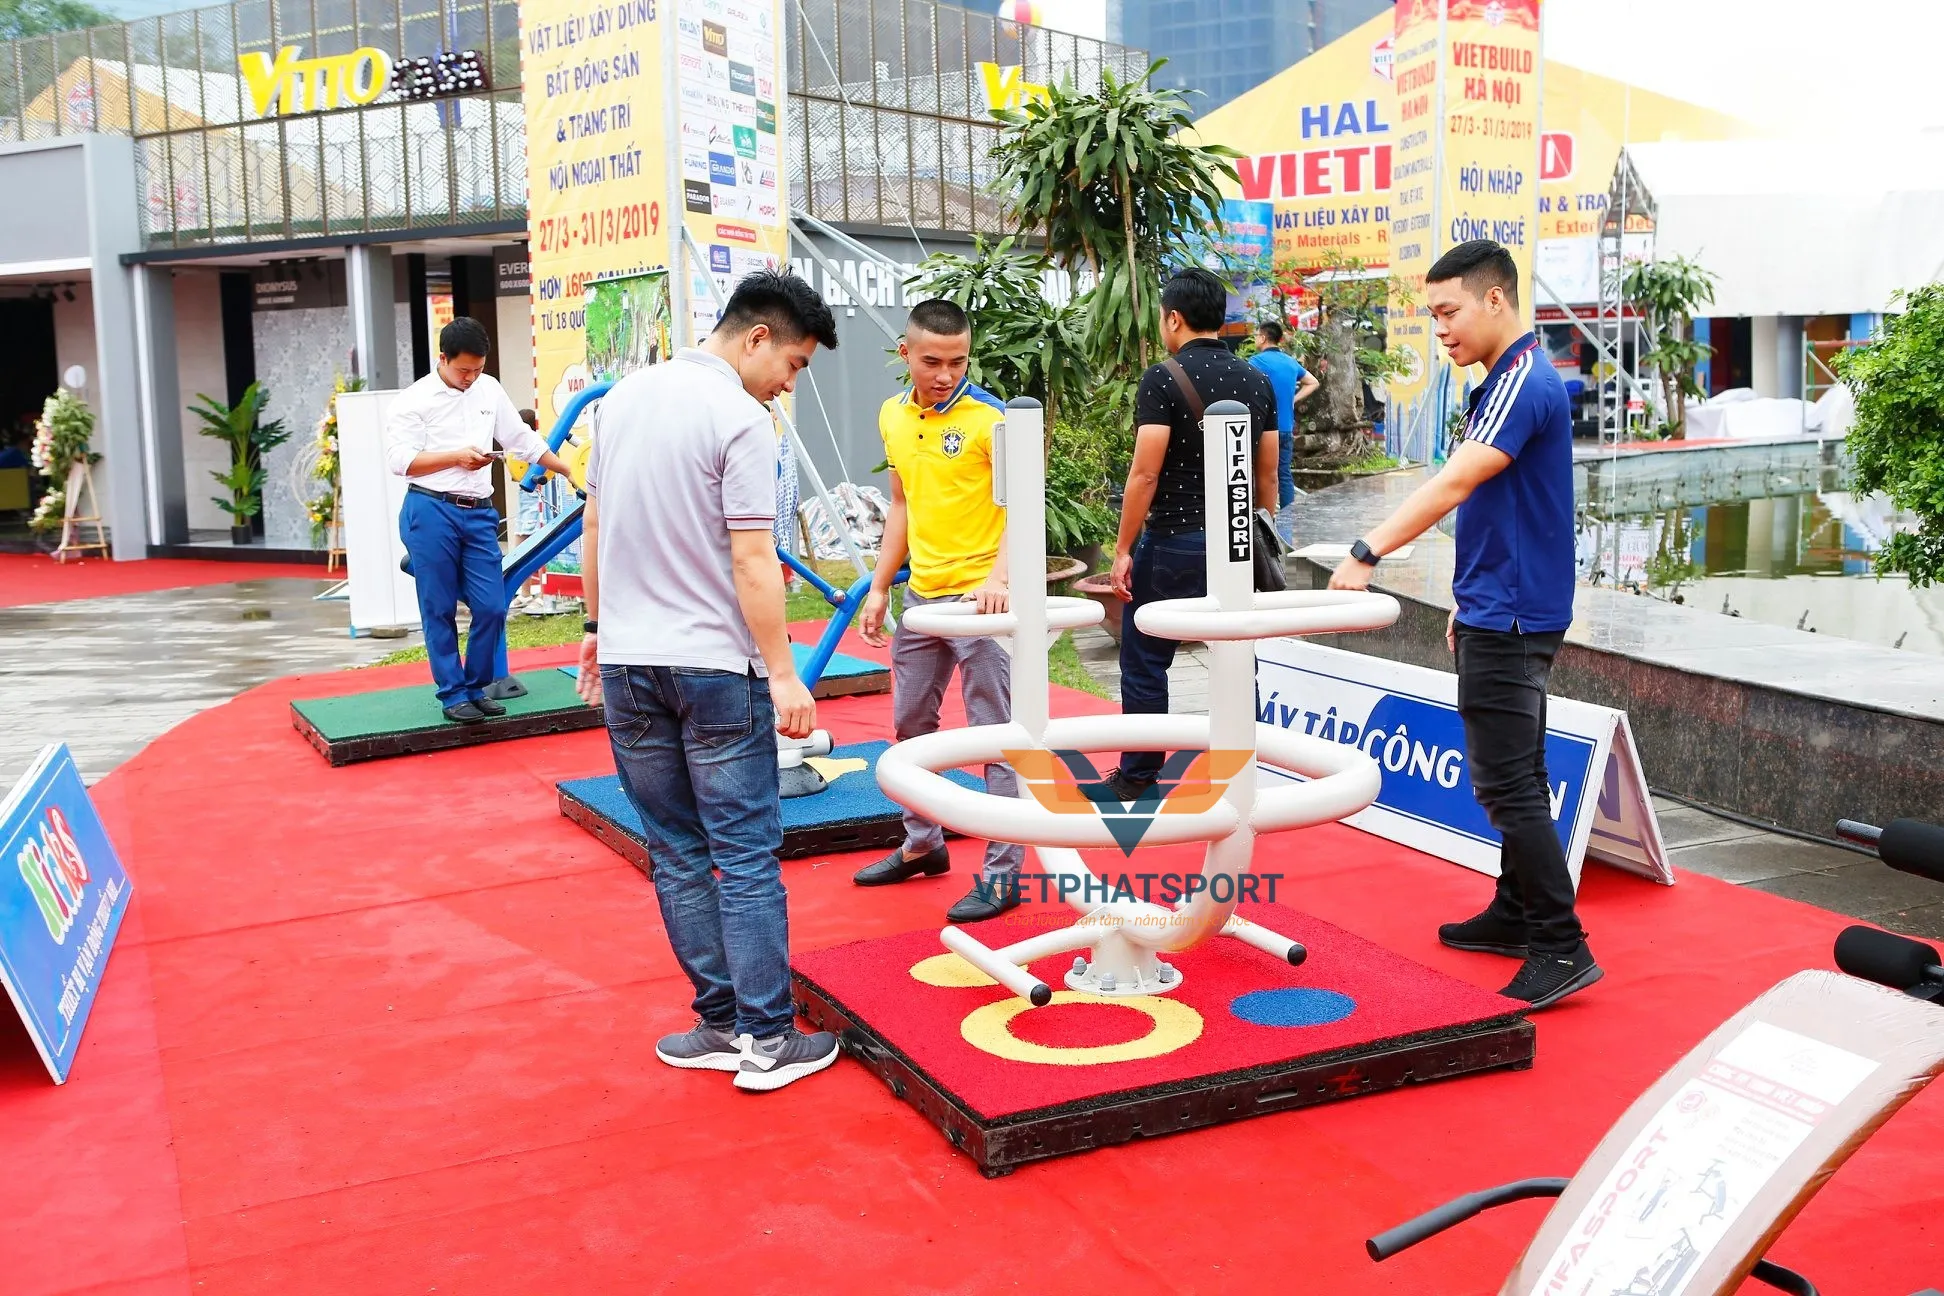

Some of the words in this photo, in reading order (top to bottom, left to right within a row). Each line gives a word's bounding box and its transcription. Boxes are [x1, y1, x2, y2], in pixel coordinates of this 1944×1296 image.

[528, 23, 551, 57] VẬT
[557, 14, 585, 52] LIỆU
[589, 6, 615, 41] XÂY
[546, 61, 569, 97] BẤT
[575, 57, 608, 96] ĐỘNG
[613, 44, 640, 80] SẢN
[1453, 41, 1532, 74] VIETBUILD
[238, 45, 393, 117] VITTO
[1464, 72, 1487, 100] HÀ
[1492, 76, 1521, 109] NỘI
[557, 119, 566, 142] &
[569, 109, 607, 139] TRANG
[611, 96, 631, 130] TRÍ
[1302, 100, 1389, 139] HAL
[550, 159, 569, 195] NỘI
[572, 155, 605, 188] NGOẠI
[610, 141, 642, 178] THẤT
[1460, 161, 1483, 197] HỘI
[1488, 164, 1523, 200] NHẬP
[540, 215, 569, 253] 27/3
[581, 201, 660, 246] 31/3/2019
[1275, 209, 1299, 233] VẬT
[1305, 207, 1335, 230] LIỆU
[1342, 204, 1369, 224] XÂY
[1451, 211, 1488, 242] CÔNG
[1493, 215, 1525, 250] NGHỆ
[1298, 232, 1360, 248] Materials
[539, 275, 561, 301] HƠN
[822, 258, 895, 317] GẠCH
[556, 311, 567, 330] 18
[1229, 425, 1250, 557] VIFASPORT
[1363, 724, 1464, 789] CÔNG
